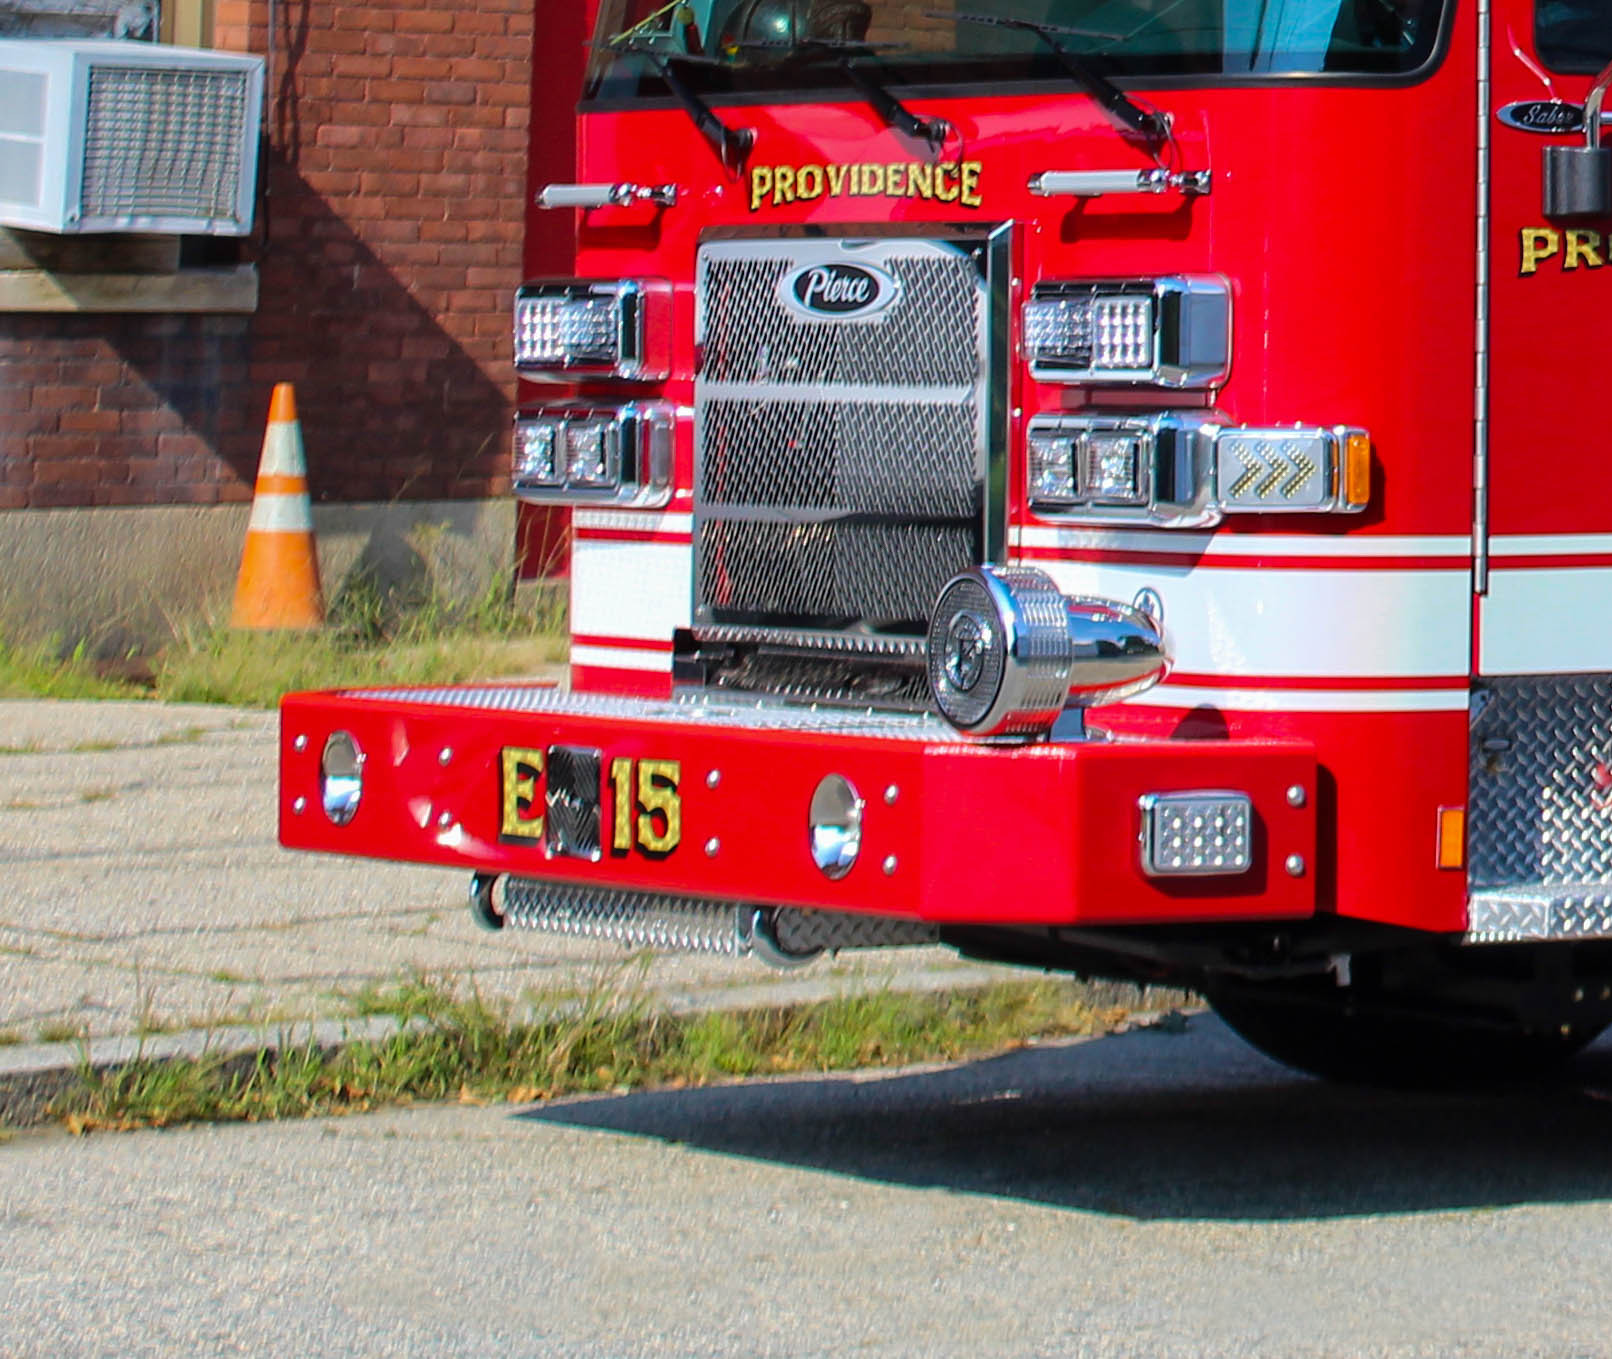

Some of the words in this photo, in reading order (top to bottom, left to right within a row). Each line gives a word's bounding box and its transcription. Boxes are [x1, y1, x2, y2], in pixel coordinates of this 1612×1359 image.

[750, 162, 983, 210] PROVIDENCE
[803, 267, 871, 307] Pierce
[498, 745, 545, 846] E
[609, 755, 683, 861] 15
